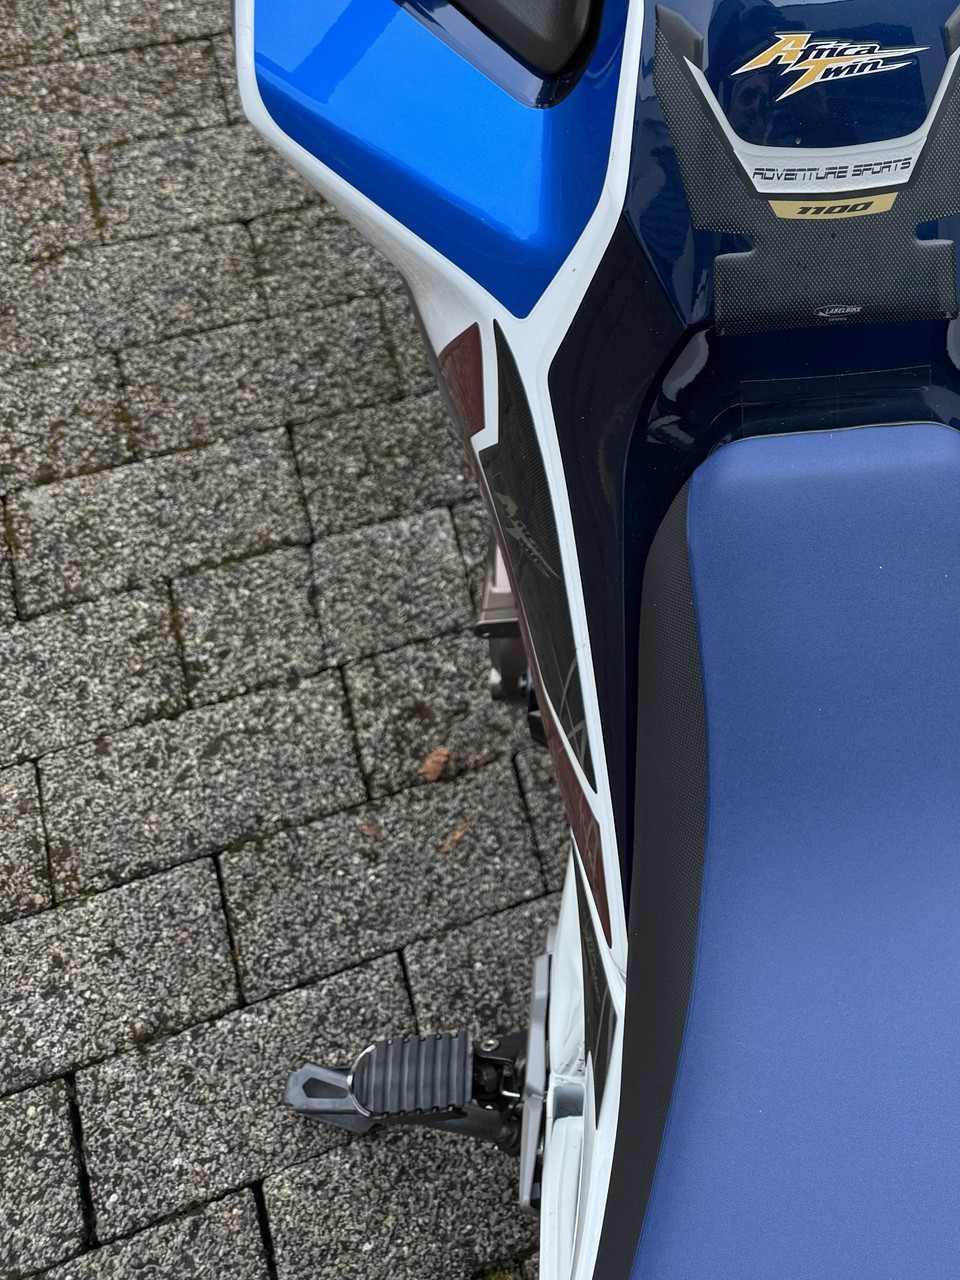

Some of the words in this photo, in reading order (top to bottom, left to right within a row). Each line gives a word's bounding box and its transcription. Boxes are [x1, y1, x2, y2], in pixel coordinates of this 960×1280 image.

[731, 31, 931, 77] Africa
[775, 55, 915, 102] Twin
[752, 165, 849, 181] ADVENTURE
[851, 157, 913, 176] SPORTS
[797, 200, 875, 216] 1100
